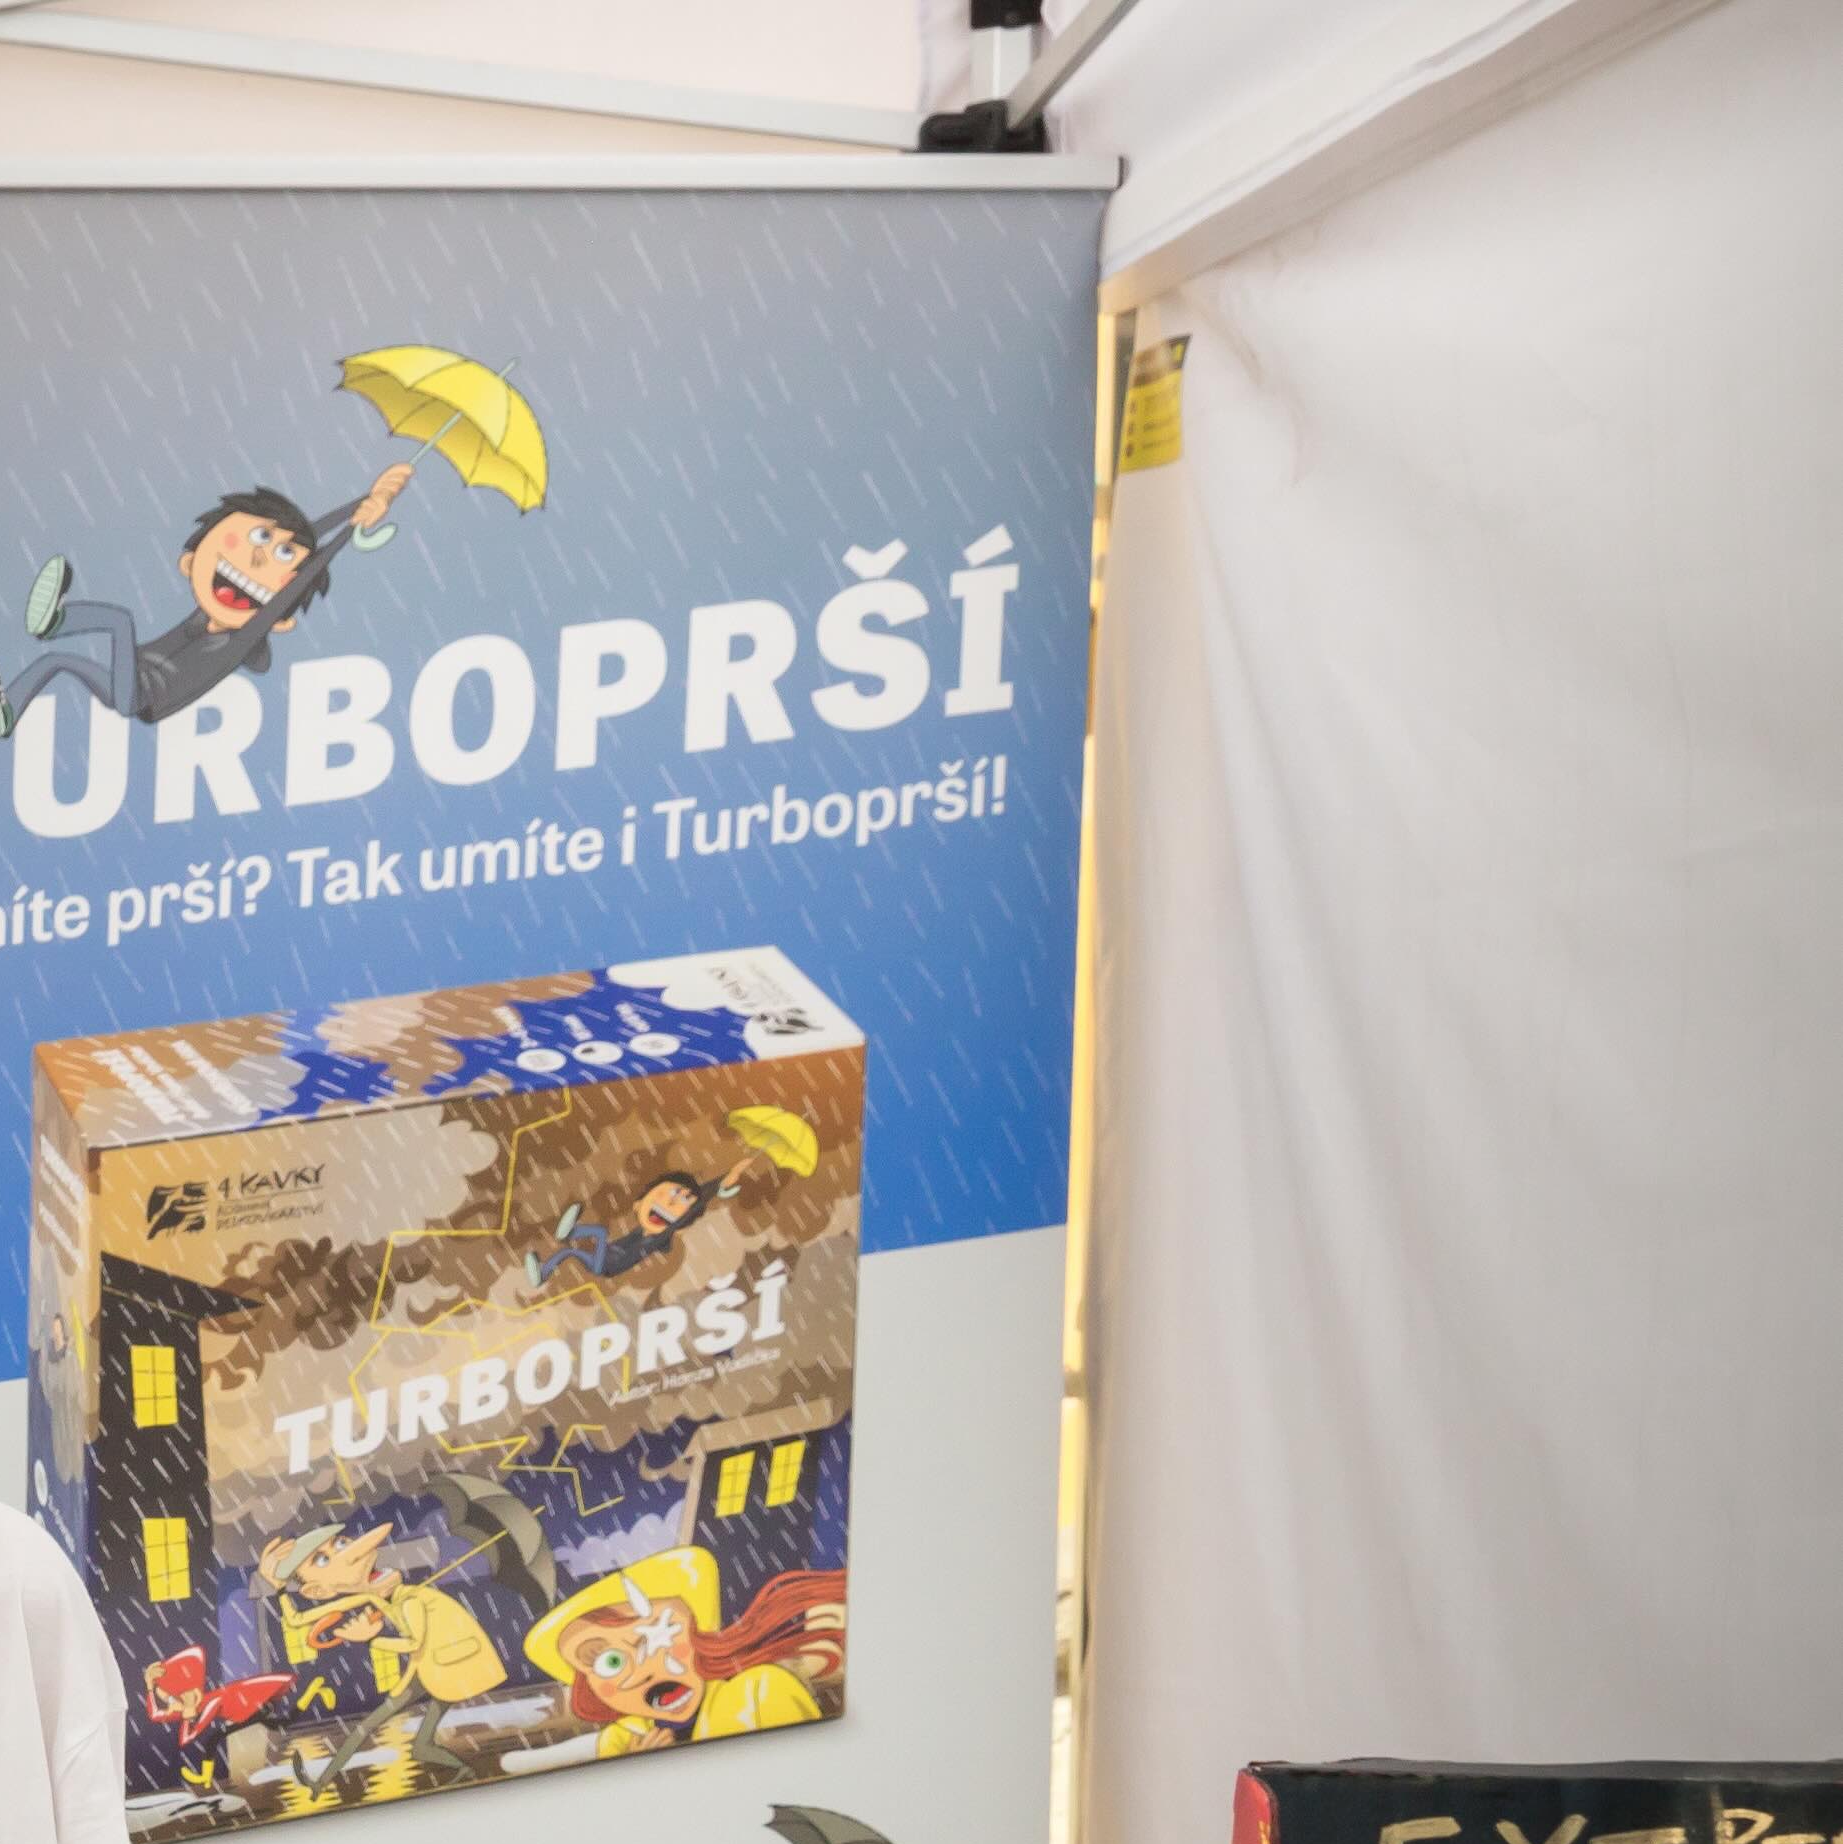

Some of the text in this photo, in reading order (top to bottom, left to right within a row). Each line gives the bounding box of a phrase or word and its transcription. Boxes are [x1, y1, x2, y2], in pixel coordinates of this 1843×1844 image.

[108, 856, 274, 948] prší?
[287, 836, 404, 907] Tak
[417, 810, 607, 896] umíte
[617, 805, 637, 866] i
[653, 757, 1008, 862] Turboprší!
[218, 1163, 326, 1199] 4 KAVKY
[273, 1261, 790, 1477] TURBOPRŠÍ
